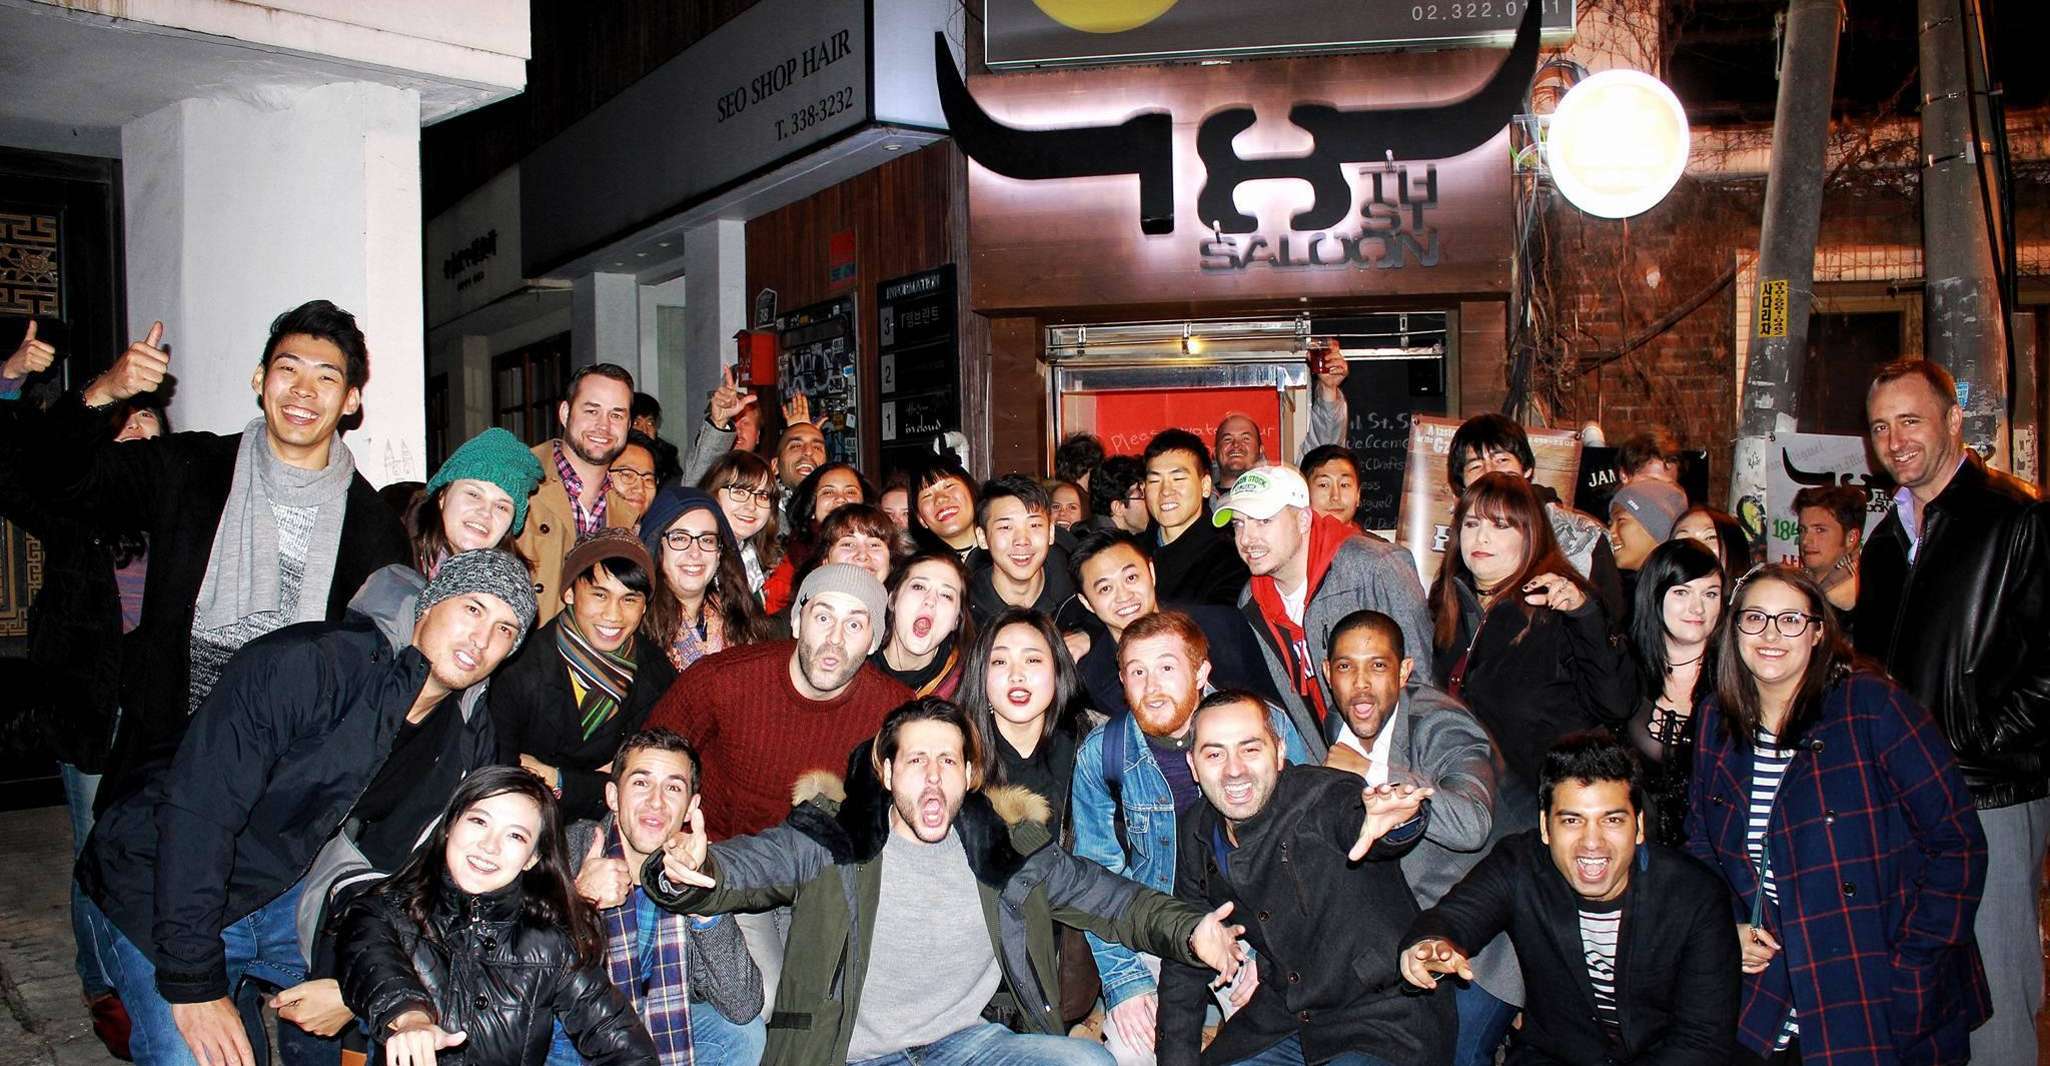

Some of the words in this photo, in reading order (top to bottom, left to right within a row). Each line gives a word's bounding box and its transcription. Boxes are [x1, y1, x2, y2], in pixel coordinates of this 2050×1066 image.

[1411, 0, 1559, 21] 02.322.01
[717, 86, 747, 123] SEO
[751, 58, 797, 105] SHOP
[802, 29, 852, 78] HAIR
[775, 120, 788, 141] T.
[791, 86, 853, 135] 338-3232
[1200, 230, 1440, 272] SALOON
[884, 317, 890, 336] 3
[885, 367, 891, 384] 2
